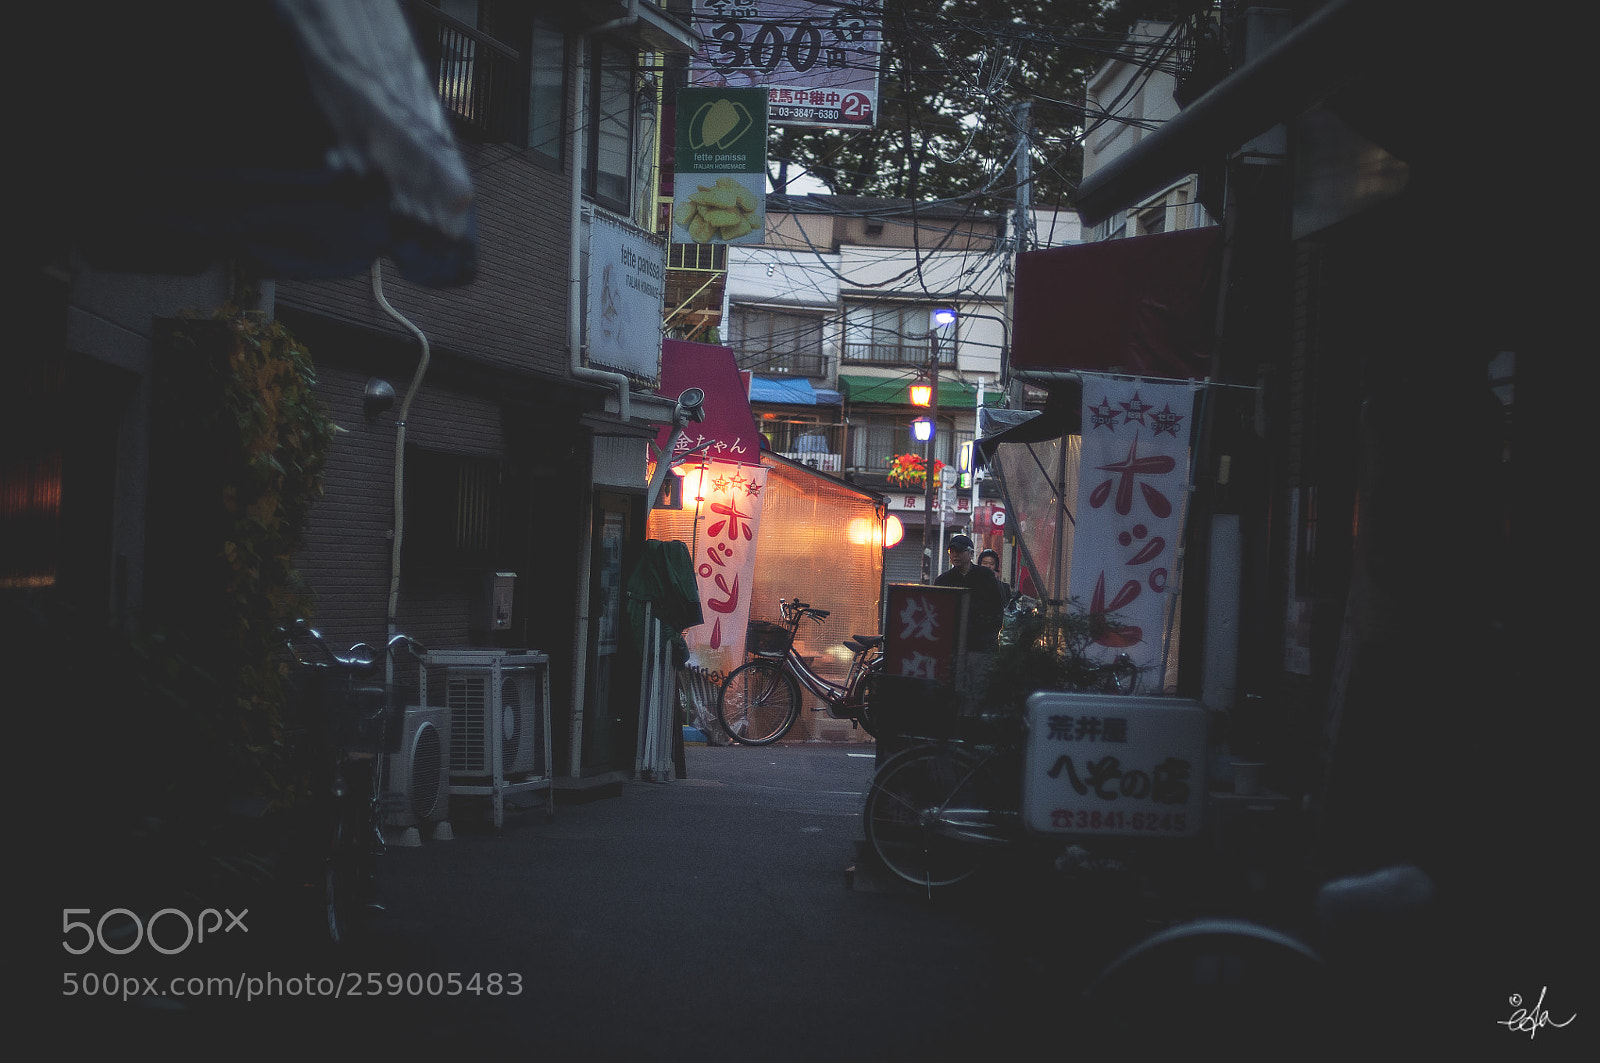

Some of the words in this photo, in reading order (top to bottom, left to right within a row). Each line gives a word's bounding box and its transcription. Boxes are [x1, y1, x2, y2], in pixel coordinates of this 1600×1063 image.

[778, 107, 839, 120] 03-3847-6380
[845, 95, 870, 116] 2F
[694, 152, 713, 161] fette
[715, 152, 747, 163] panissa
[620, 243, 637, 269] fette
[637, 255, 660, 281] panissa
[674, 430, 747, 454] 金ちゃん
[1089, 428, 1176, 652] ホッピ
[1046, 754, 1191, 805] へその店
